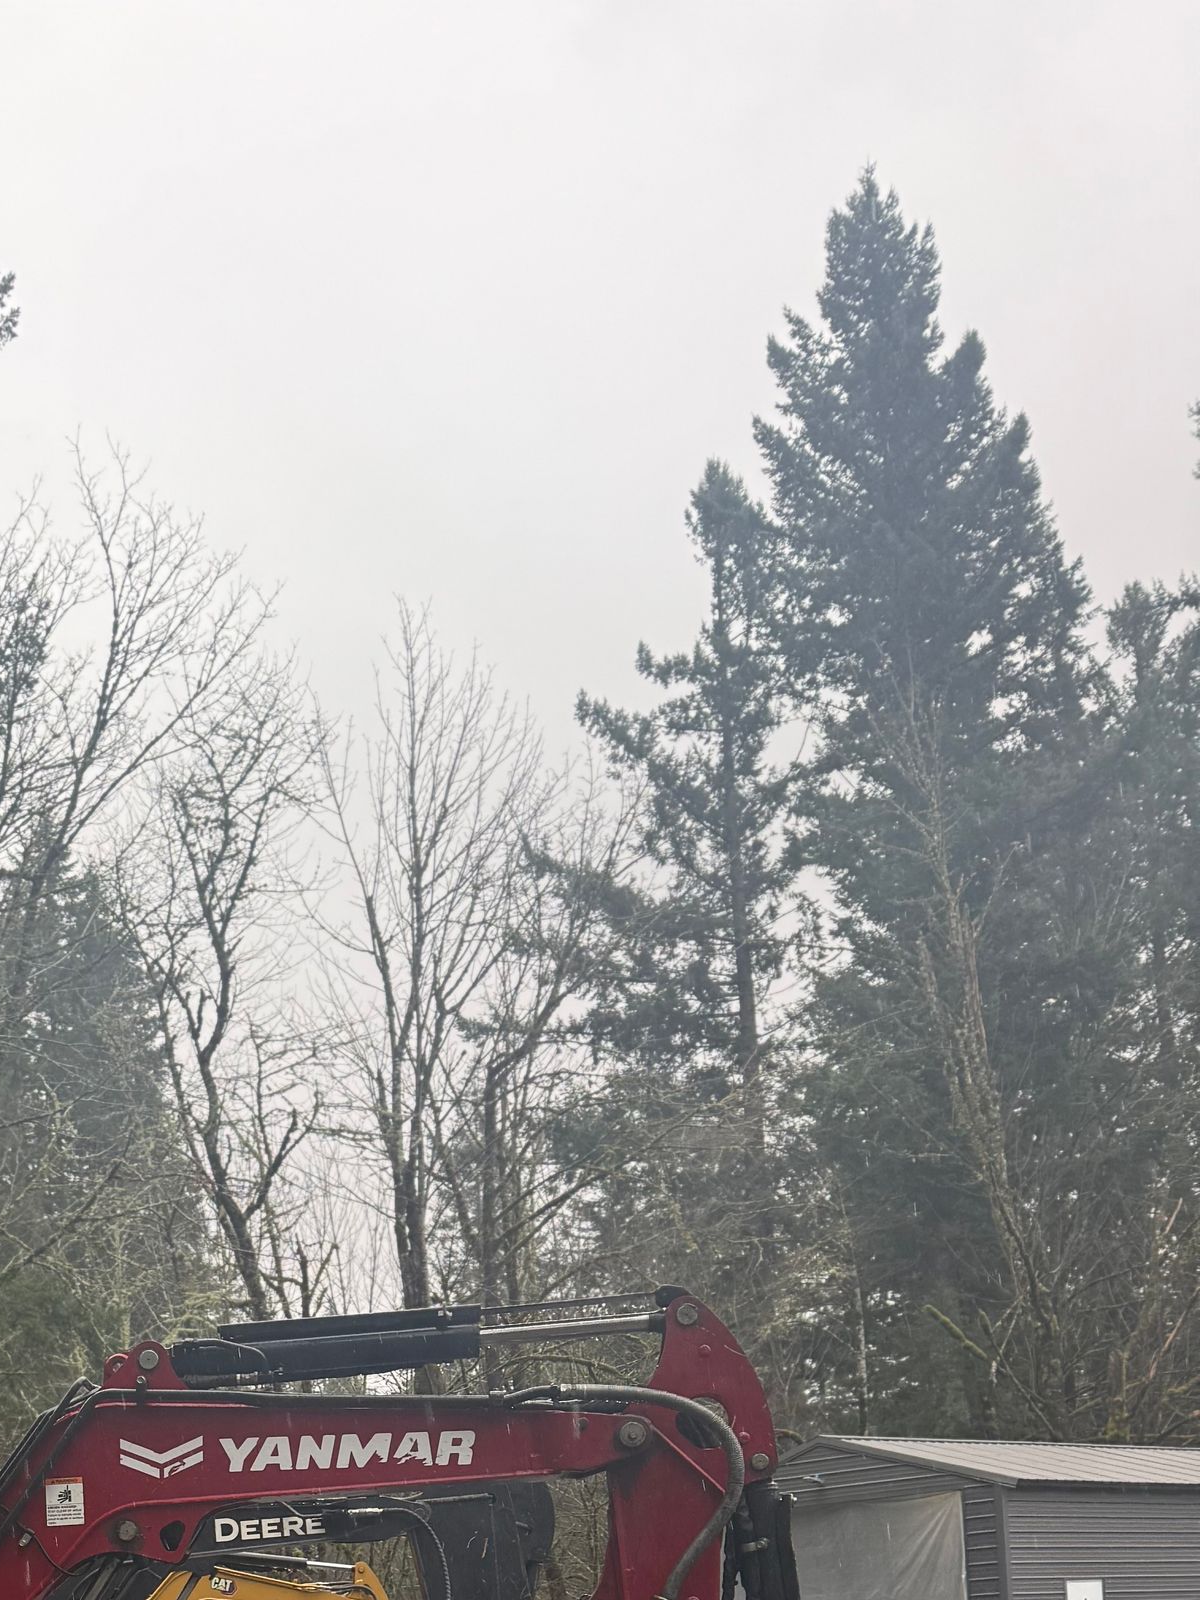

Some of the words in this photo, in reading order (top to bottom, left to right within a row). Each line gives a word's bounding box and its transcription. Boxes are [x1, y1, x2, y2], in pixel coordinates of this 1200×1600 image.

[219, 1430, 477, 1473] YANMAR
[214, 1517, 326, 1543] DEERE
[211, 1576, 233, 1592] CAT
